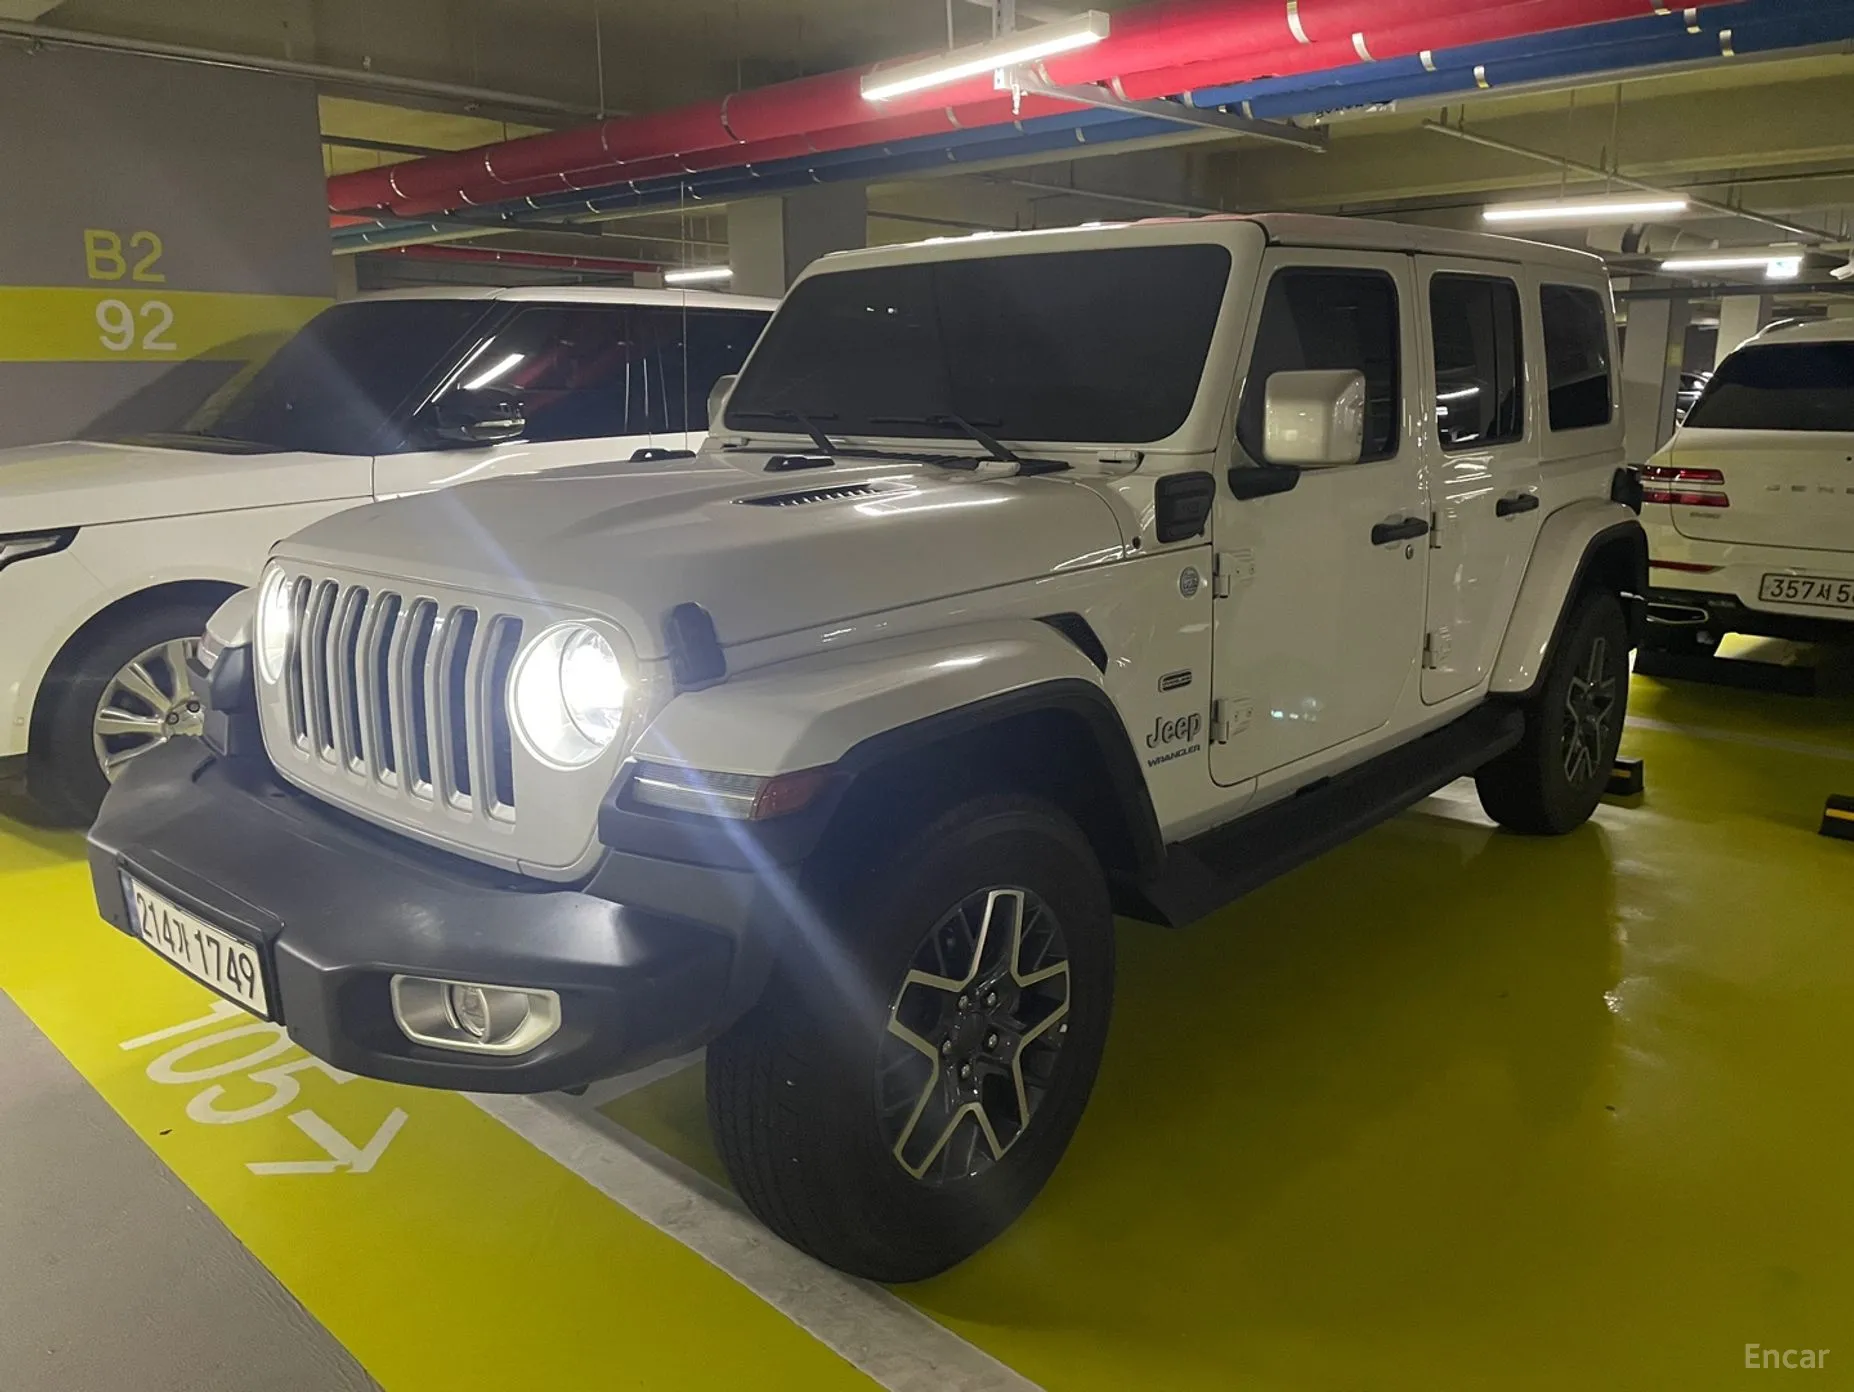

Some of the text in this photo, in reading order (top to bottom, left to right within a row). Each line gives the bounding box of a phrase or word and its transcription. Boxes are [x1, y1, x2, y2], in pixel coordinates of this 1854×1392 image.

[83, 228, 166, 283] B2
[95, 299, 178, 351] 92
[1770, 578, 1854, 603] 357서 5
[1146, 712, 1202, 749] Jeep
[1147, 743, 1201, 768] WRANGLER
[194, 929, 256, 1000] 1749
[118, 999, 358, 1124] 105
